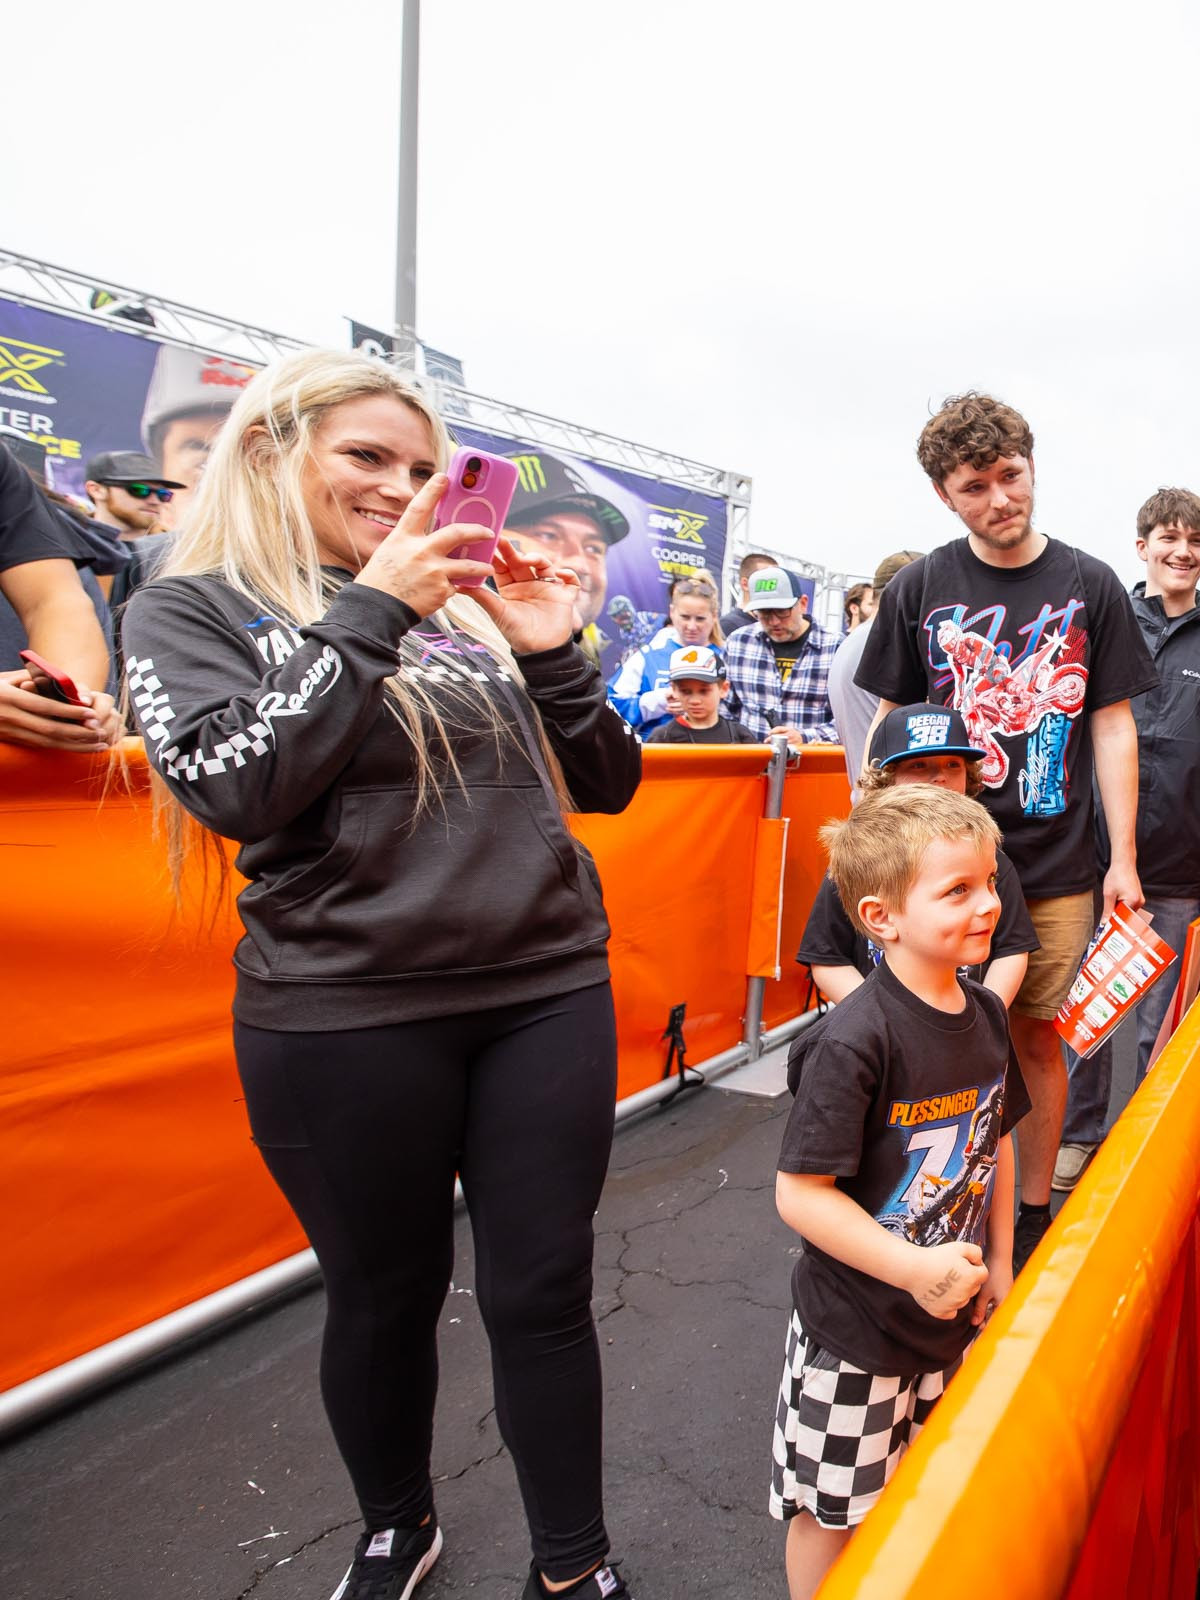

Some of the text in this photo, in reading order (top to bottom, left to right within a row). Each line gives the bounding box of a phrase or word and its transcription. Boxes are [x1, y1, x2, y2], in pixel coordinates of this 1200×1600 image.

[651, 546, 706, 568] COOPER
[681, 650, 699, 663] 4
[255, 644, 343, 751] Racing
[908, 714, 950, 728] DEEGAN
[909, 725, 948, 751] 38
[890, 1088, 978, 1127] PLESSINGER
[900, 1124, 959, 1202] 7
[978, 1165, 991, 1182] 7
